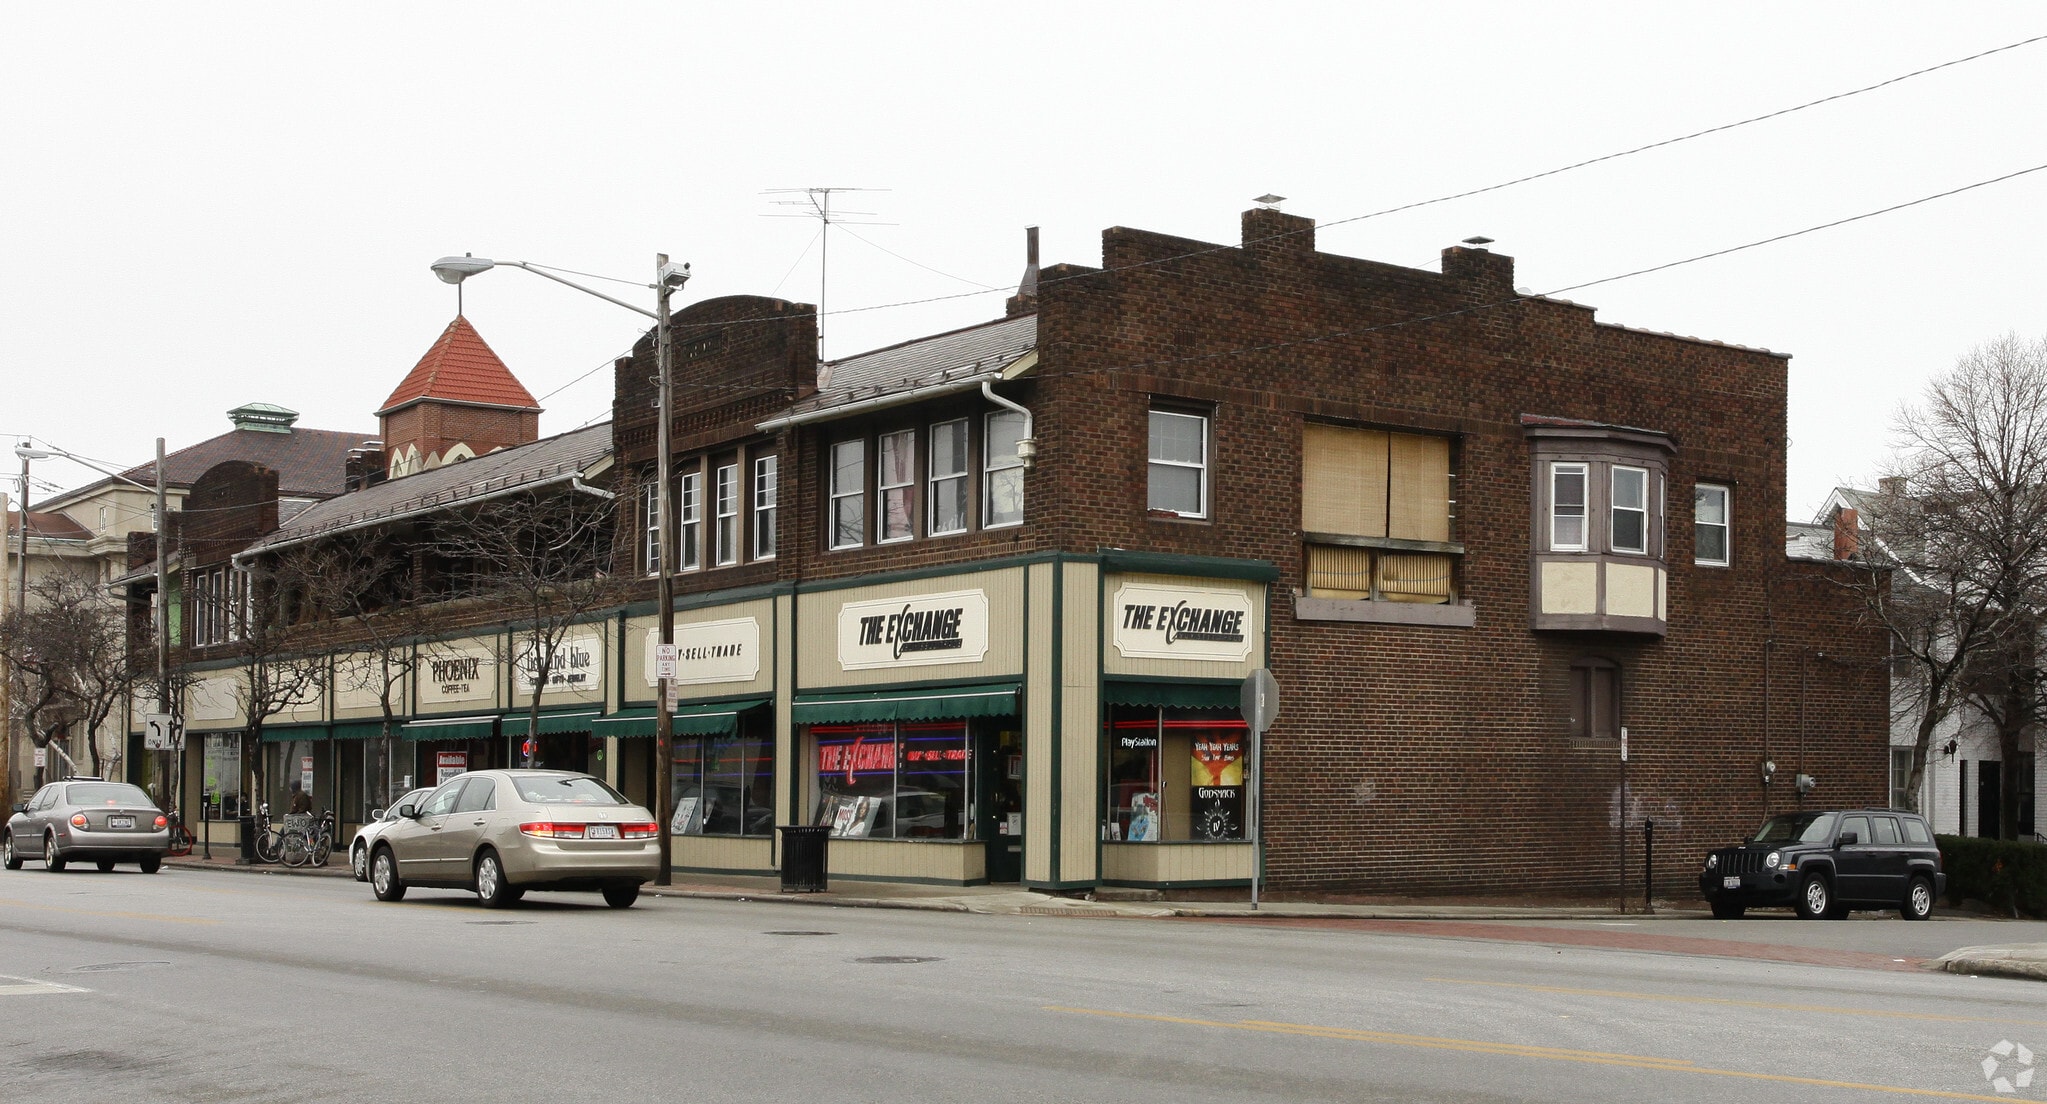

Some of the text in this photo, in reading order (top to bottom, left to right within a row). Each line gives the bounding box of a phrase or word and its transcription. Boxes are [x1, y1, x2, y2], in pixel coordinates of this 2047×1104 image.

[859, 604, 963, 660] THE EXCHANGE
[1123, 600, 1244, 645] THE EXCHANGE
[432, 657, 479, 682] PHOENIX
[570, 646, 590, 668] blue
[1121, 737, 1157, 748] PlayStation
[819, 745, 842, 770] THE
